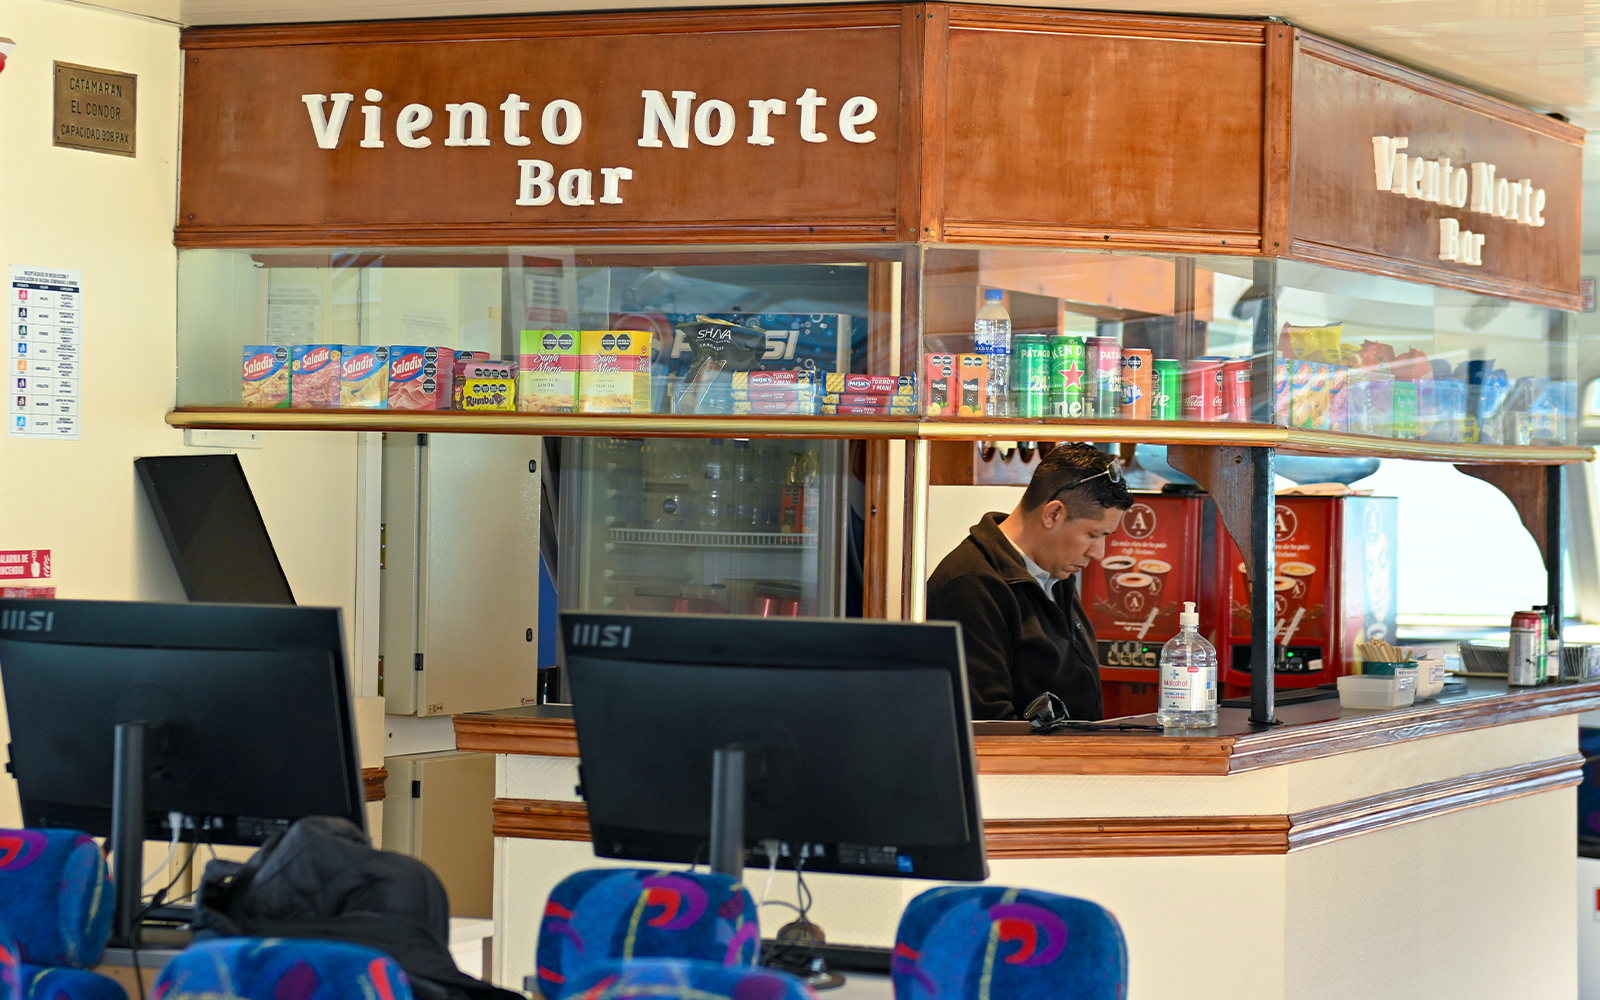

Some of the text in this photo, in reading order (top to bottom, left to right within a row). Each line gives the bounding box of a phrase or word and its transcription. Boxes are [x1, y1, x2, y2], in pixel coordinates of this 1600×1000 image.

[70, 77, 122, 97] CATAMARAN
[71, 100, 121, 120] EL CONDOR
[302, 87, 878, 149] Viento Norte
[61, 124, 129, 144] CAPACIDAD 308 PAX
[515, 159, 632, 207] Bar
[1372, 136, 1546, 227] Viento Norte
[1439, 218, 1485, 266] Bar
[696, 328, 732, 340] SHIVA
[243, 355, 274, 377] Saladix
[302, 349, 330, 369] Saladix
[342, 355, 374, 377] Saladix
[391, 356, 423, 378] Saladix
[533, 350, 560, 364] Santa
[593, 350, 618, 364] Santa
[848, 380, 871, 388] MISKY
[1131, 512, 1148, 530] A
[22, 554, 29, 563] DE
[2, 610, 54, 632] MSI
[572, 624, 632, 648] MSI
